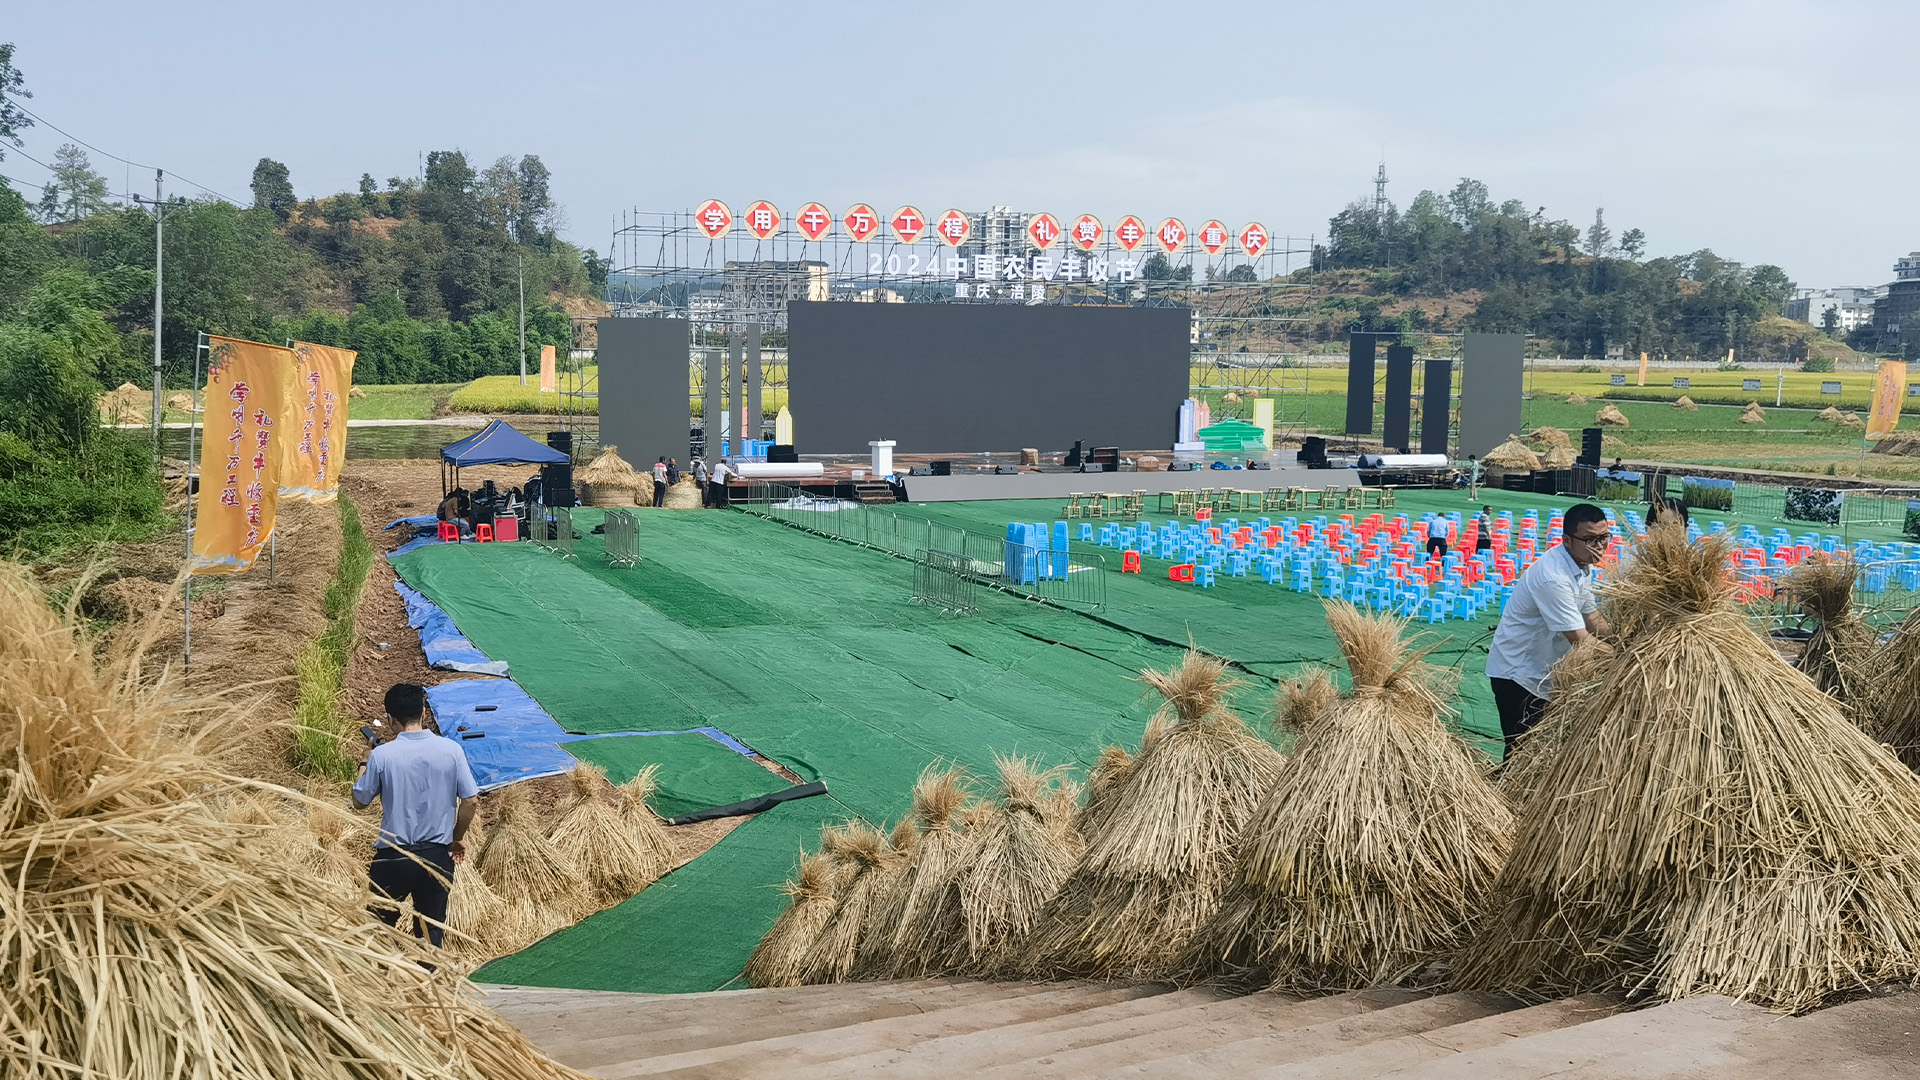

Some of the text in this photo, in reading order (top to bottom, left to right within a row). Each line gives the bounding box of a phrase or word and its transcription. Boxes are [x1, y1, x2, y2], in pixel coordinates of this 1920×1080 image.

[704, 208, 1262, 249] 学用千万工程 礼赞丰收重庆
[869, 252, 1137, 283] 2024中国农民丰收节
